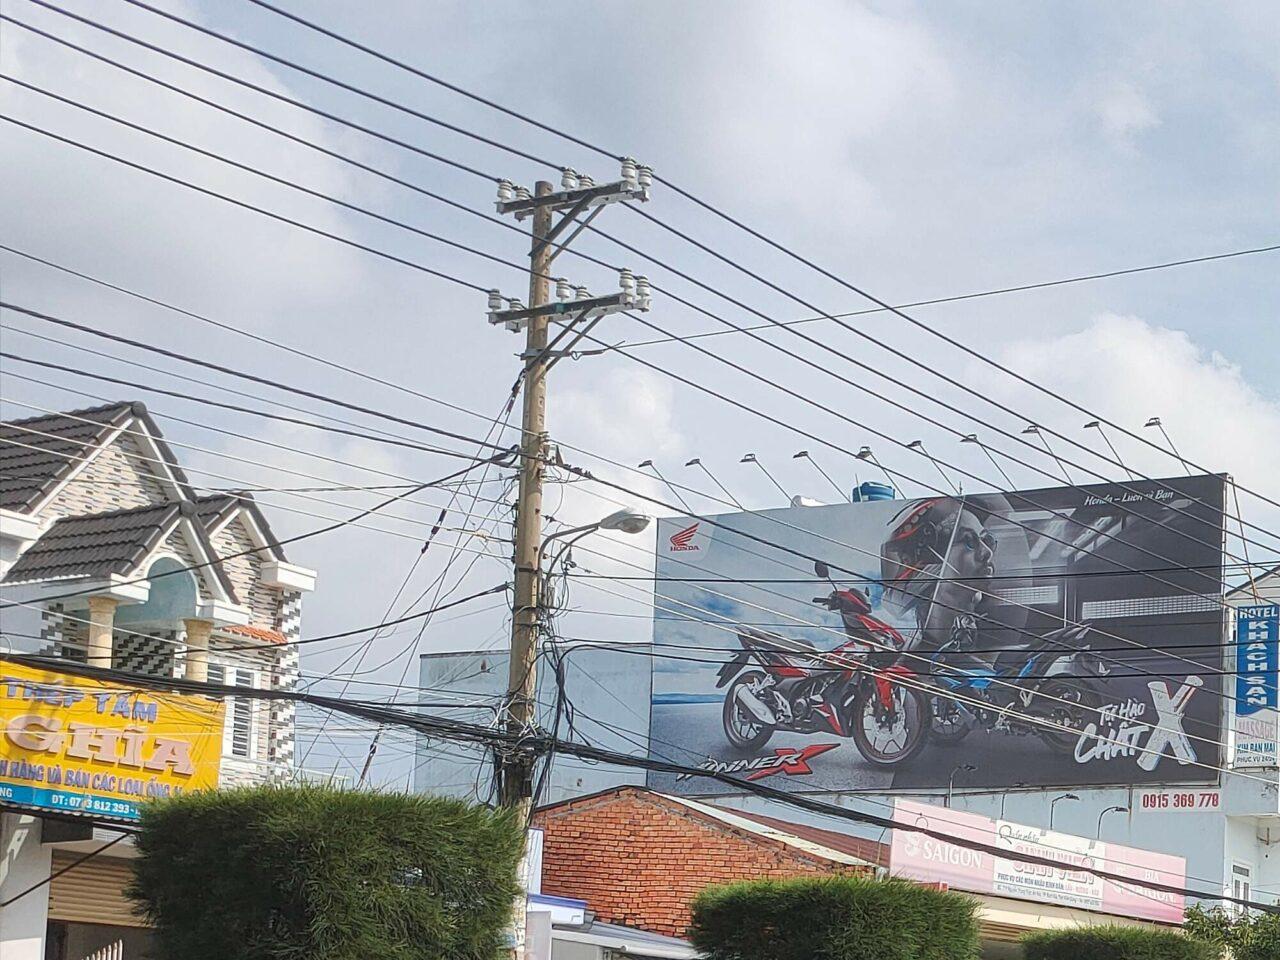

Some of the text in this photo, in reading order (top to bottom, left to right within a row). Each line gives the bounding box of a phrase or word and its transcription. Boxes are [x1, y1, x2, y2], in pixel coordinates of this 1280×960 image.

[1084, 494, 1113, 506] Honda
[1155, 489, 1174, 501] Bạn
[1239, 607, 1278, 619] HOTEL
[1119, 698, 1146, 718] HÀO
[1137, 675, 1204, 772] X
[2, 713, 194, 776] GHĨA
[92, 771, 117, 793] CÁC
[1142, 792, 1220, 809] 0915 369 778
[923, 841, 983, 870] SAIGON
